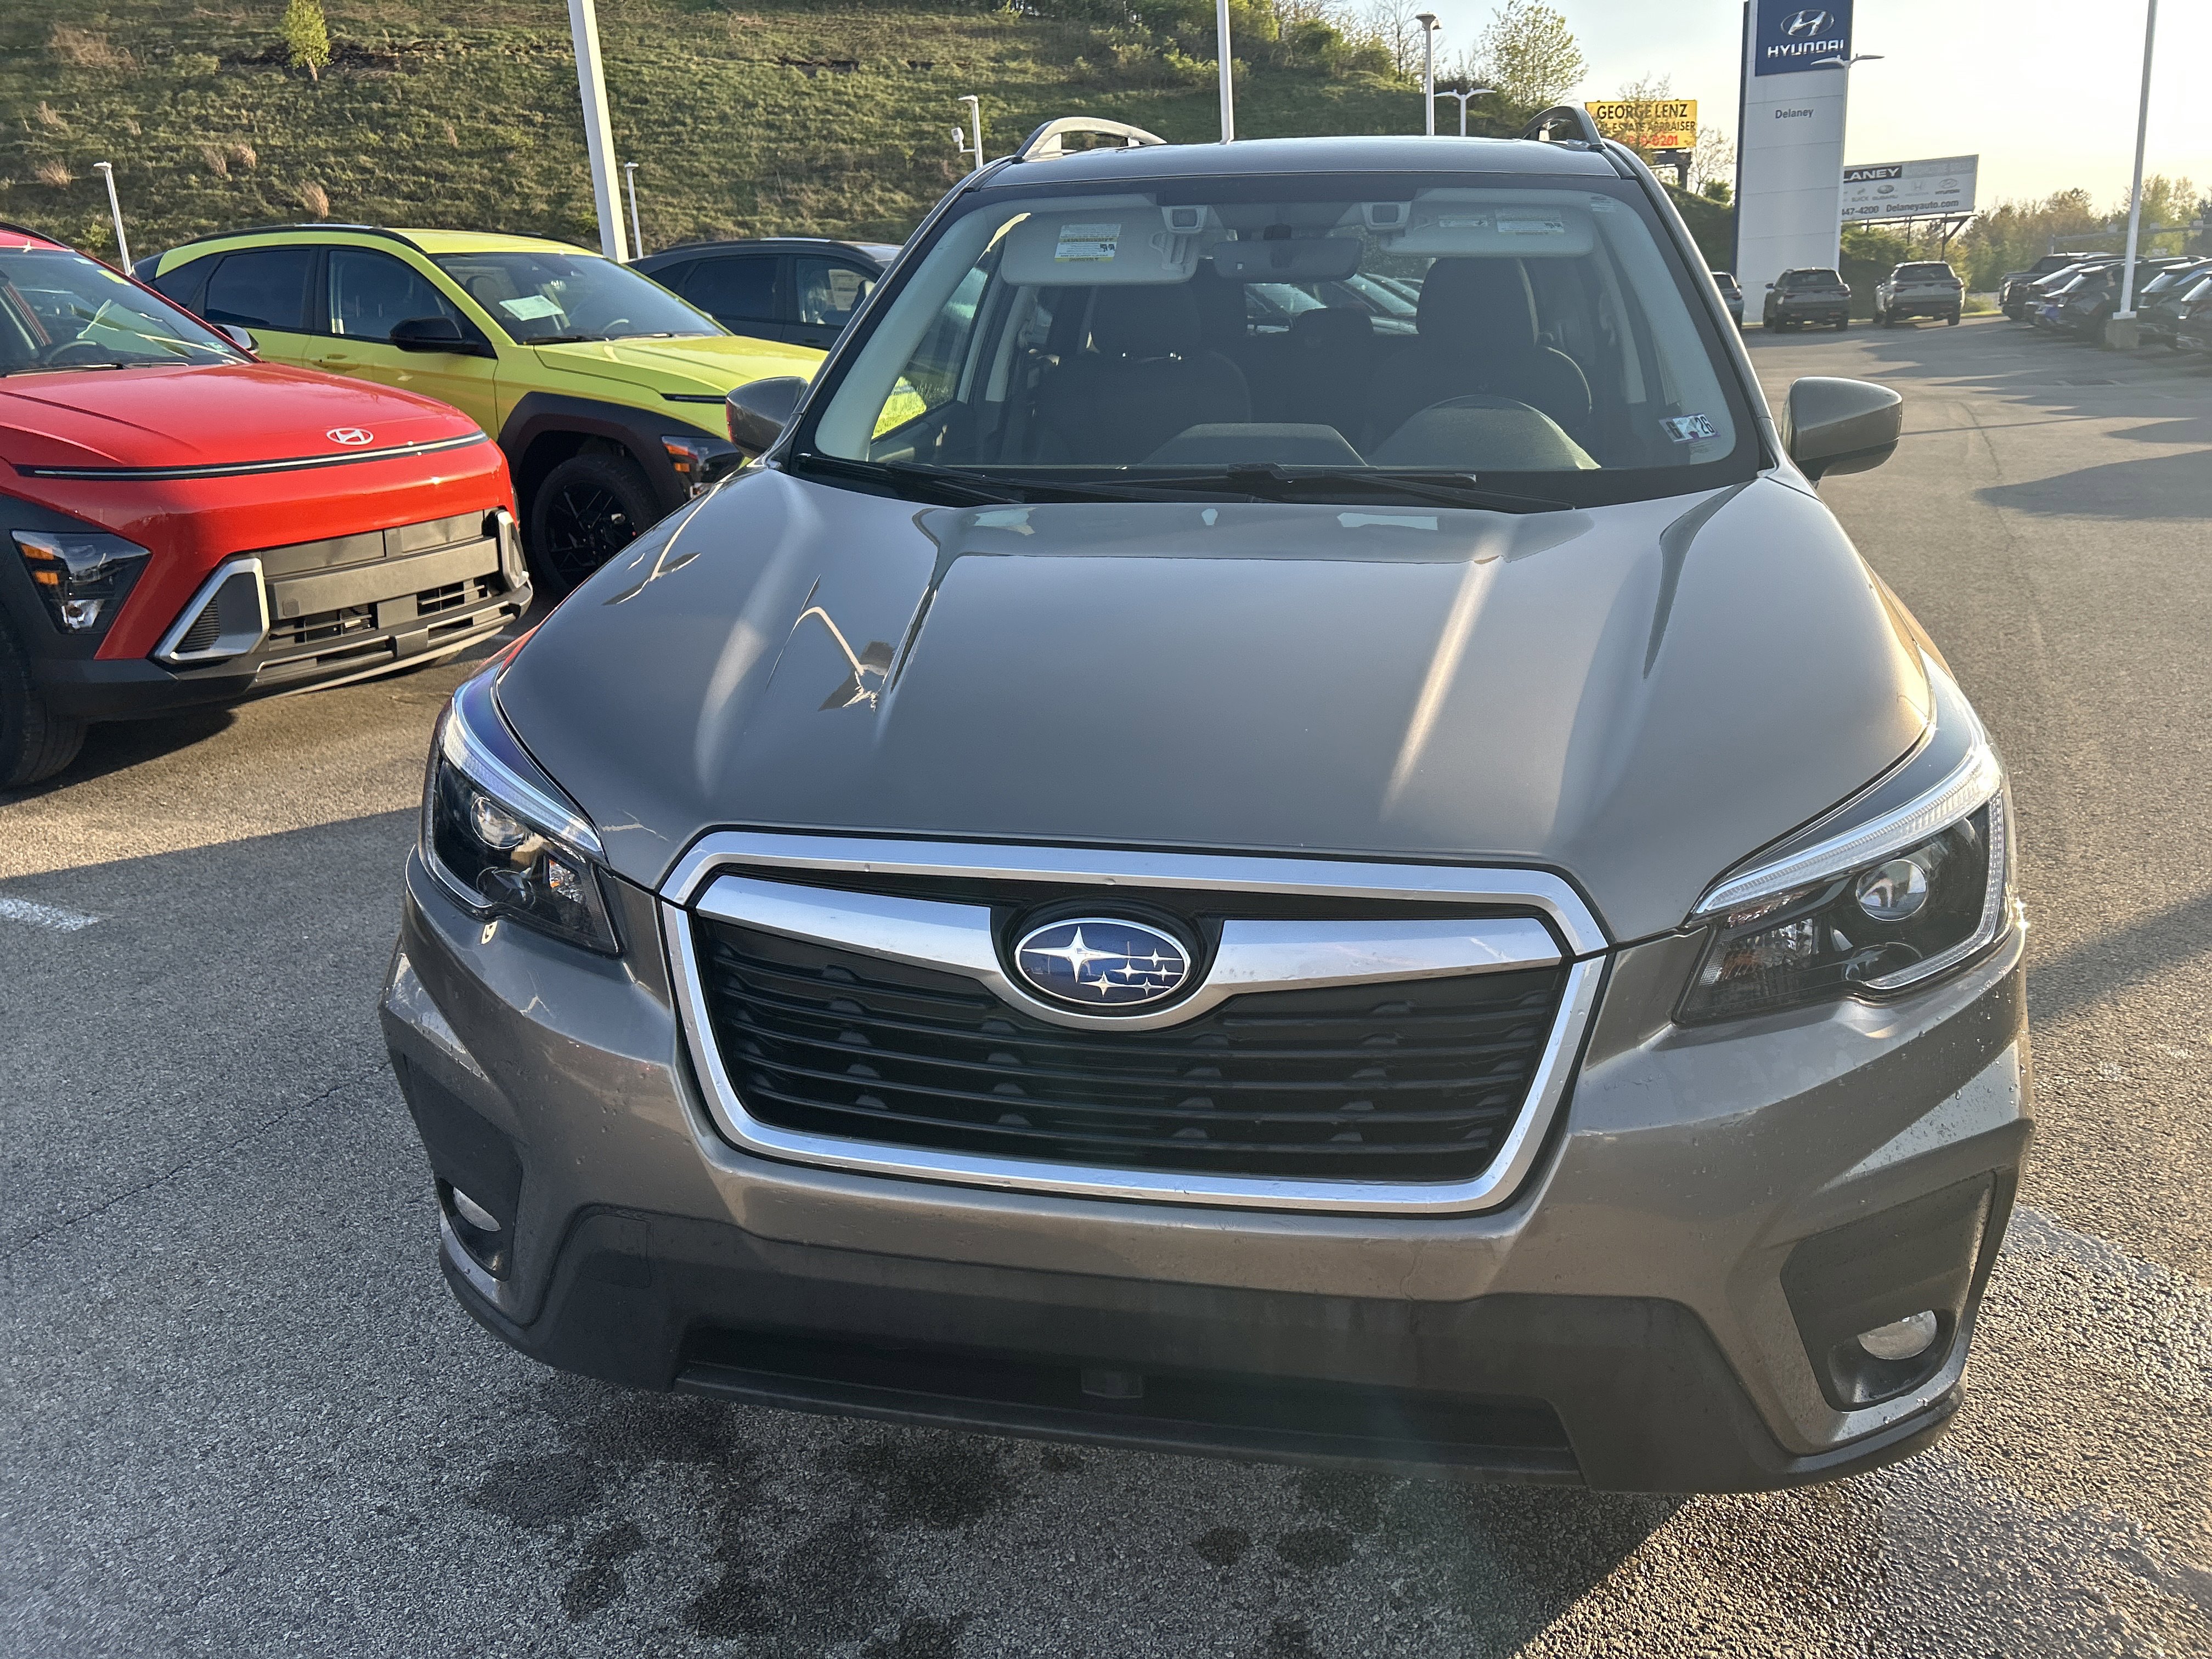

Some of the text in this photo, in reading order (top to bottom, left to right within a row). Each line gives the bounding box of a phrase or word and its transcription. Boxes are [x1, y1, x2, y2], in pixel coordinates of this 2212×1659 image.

[1768, 39, 1844, 58] HYUNDAI
[1655, 104, 1688, 118] LENZ
[1775, 109, 1814, 119] Delaney
[1886, 200, 1959, 212] Delaneyauto.com
[1694, 416, 1716, 435] 26
